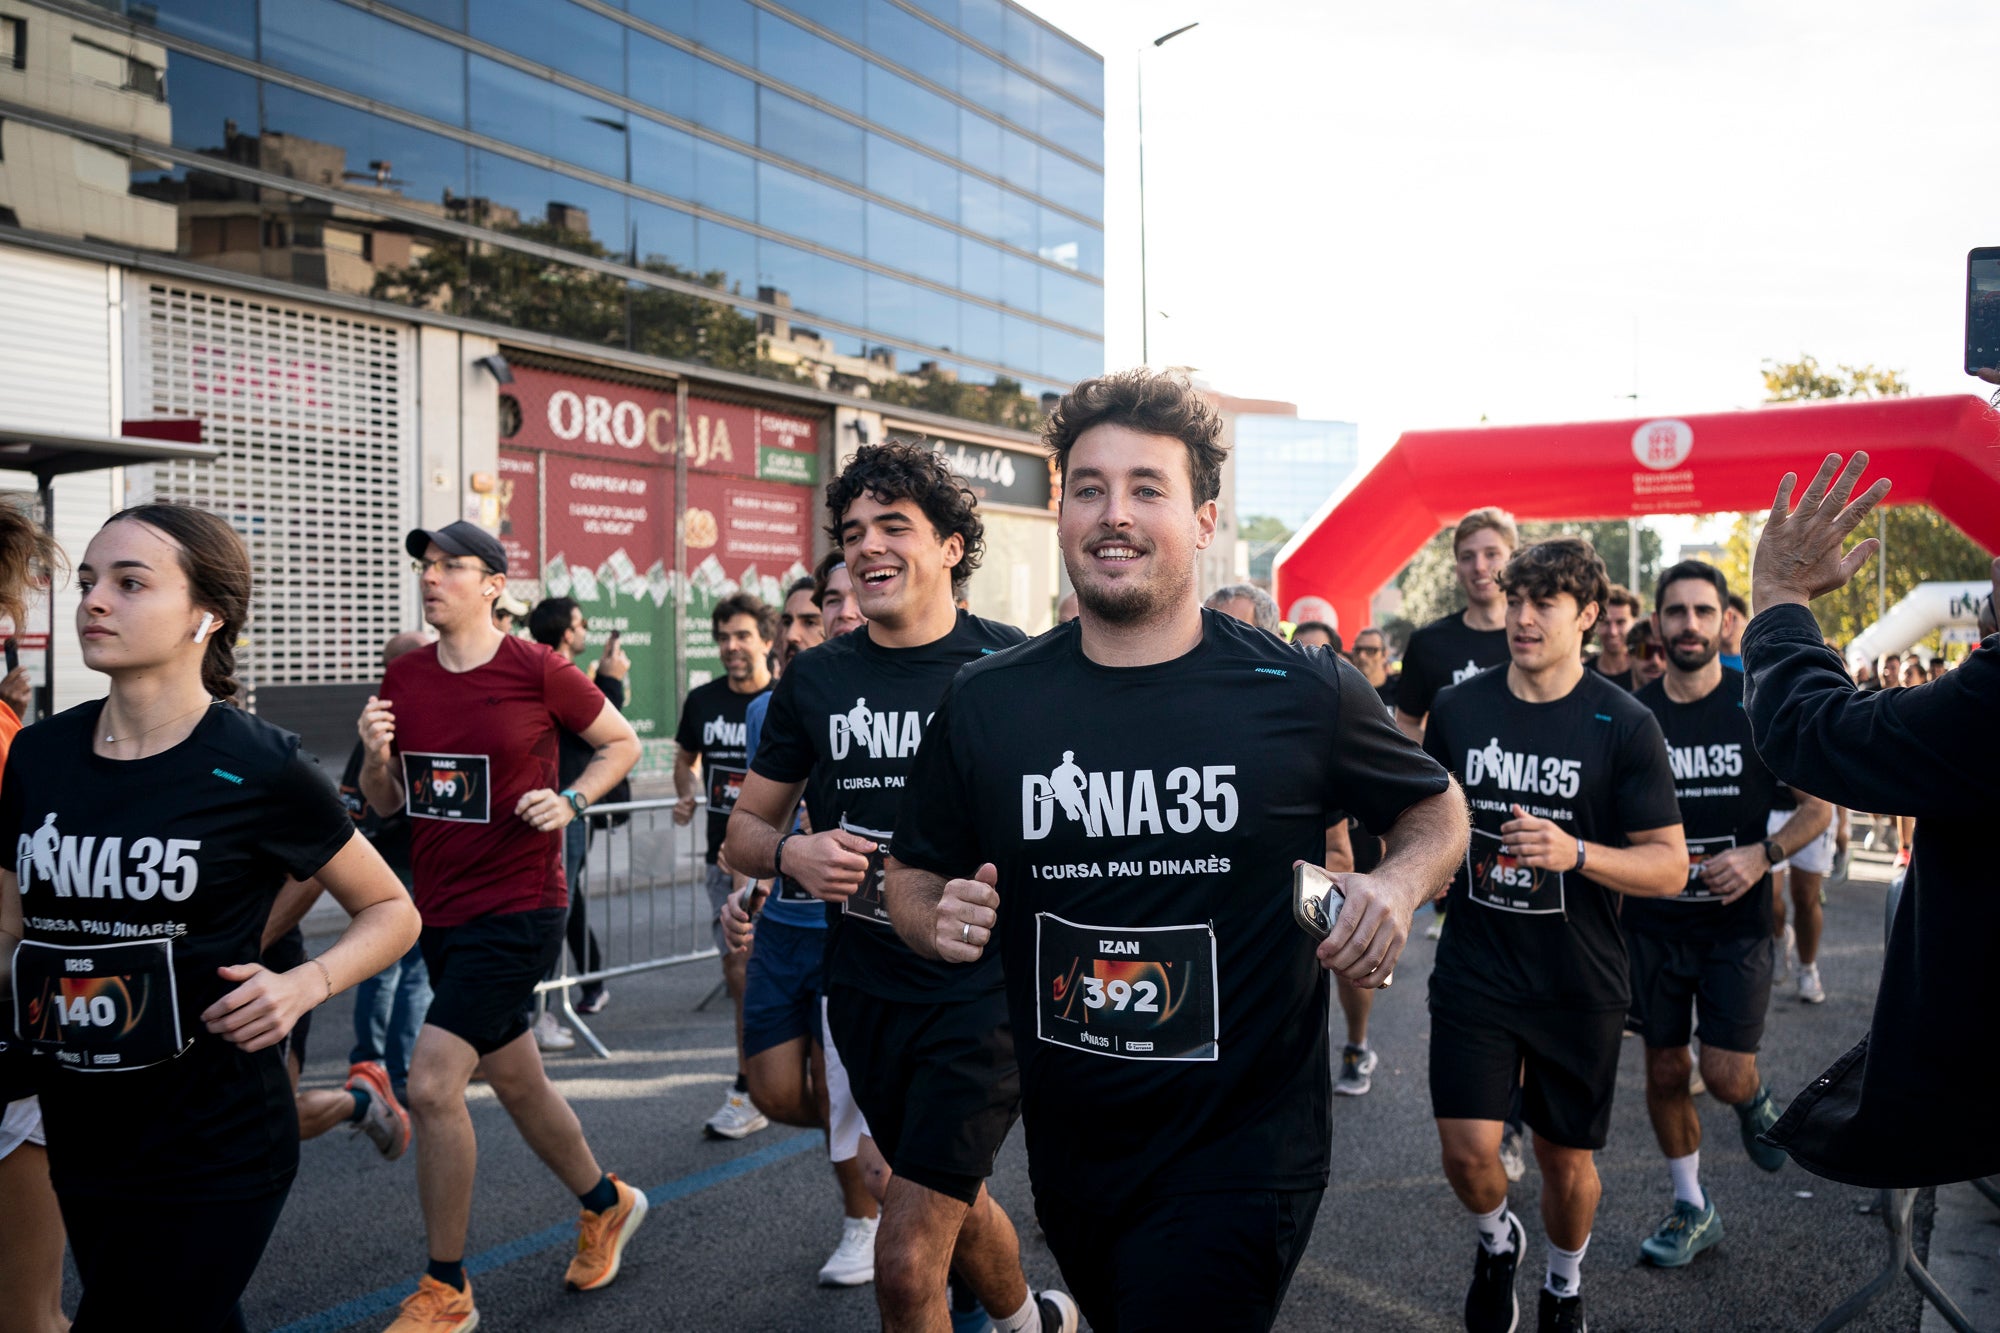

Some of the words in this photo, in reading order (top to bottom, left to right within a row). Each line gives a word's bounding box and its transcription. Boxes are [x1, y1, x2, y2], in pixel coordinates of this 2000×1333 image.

[1255, 668, 1287, 678] RUNNEK
[432, 779, 457, 797] 99
[843, 777, 881, 790] CURSA
[1042, 862, 1103, 880] CURSA
[1108, 861, 1143, 877] PAU
[1149, 854, 1231, 876] DINARÈS
[1490, 864, 1532, 888] 452
[31, 916, 79, 932] CURSA
[81, 920, 111, 935] PAU
[1099, 940, 1140, 955] IZAN
[64, 958, 95, 972] IRIS
[1083, 976, 1160, 1013] 392
[55, 995, 116, 1027] 140
